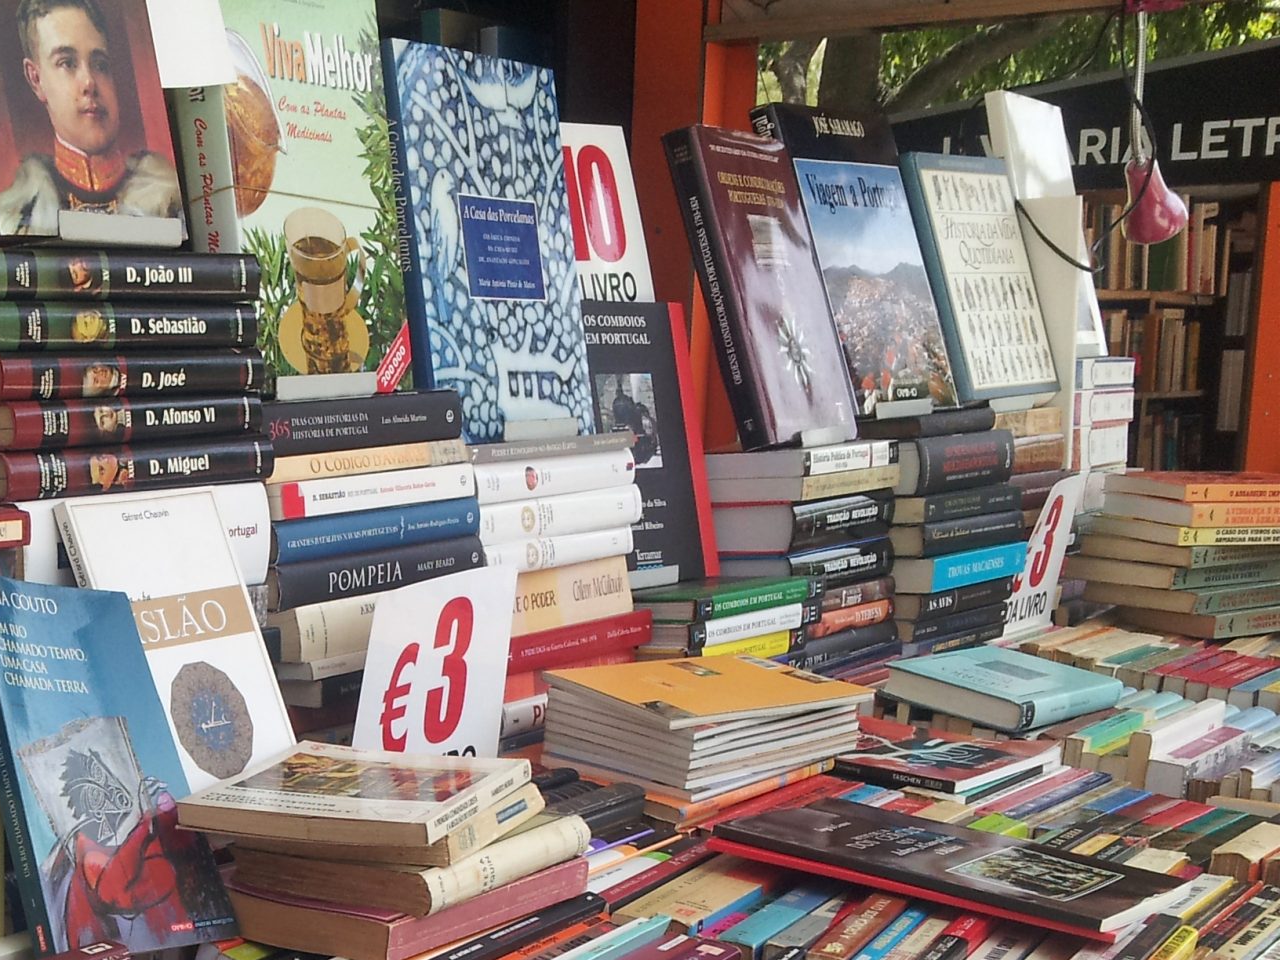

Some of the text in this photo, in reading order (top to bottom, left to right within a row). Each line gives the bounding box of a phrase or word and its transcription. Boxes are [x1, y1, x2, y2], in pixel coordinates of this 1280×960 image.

[813, 113, 829, 138] JOSÉ
[806, 174, 856, 214] Viagem a
[463, 206, 535, 224] A Casa das Porcelanas
[126, 264, 193, 285] D. João III
[131, 316, 207, 335] D. Sebastião
[584, 314, 646, 329] OS COMBOIOS
[585, 331, 650, 345] EM PORTUGAL
[145, 408, 215, 426] D. Afonso VI
[269, 421, 291, 440] 365
[851, 506, 878, 520] REVOLUÇÃO
[328, 561, 402, 593] POMPEIA
[11, 594, 57, 615] COUTO
[1020, 592, 1047, 620] LIVRO
[50, 643, 87, 661] TEMPO,
[5, 673, 89, 694] CHAMADA TERRA
[893, 773, 921, 786] TASCHEN
